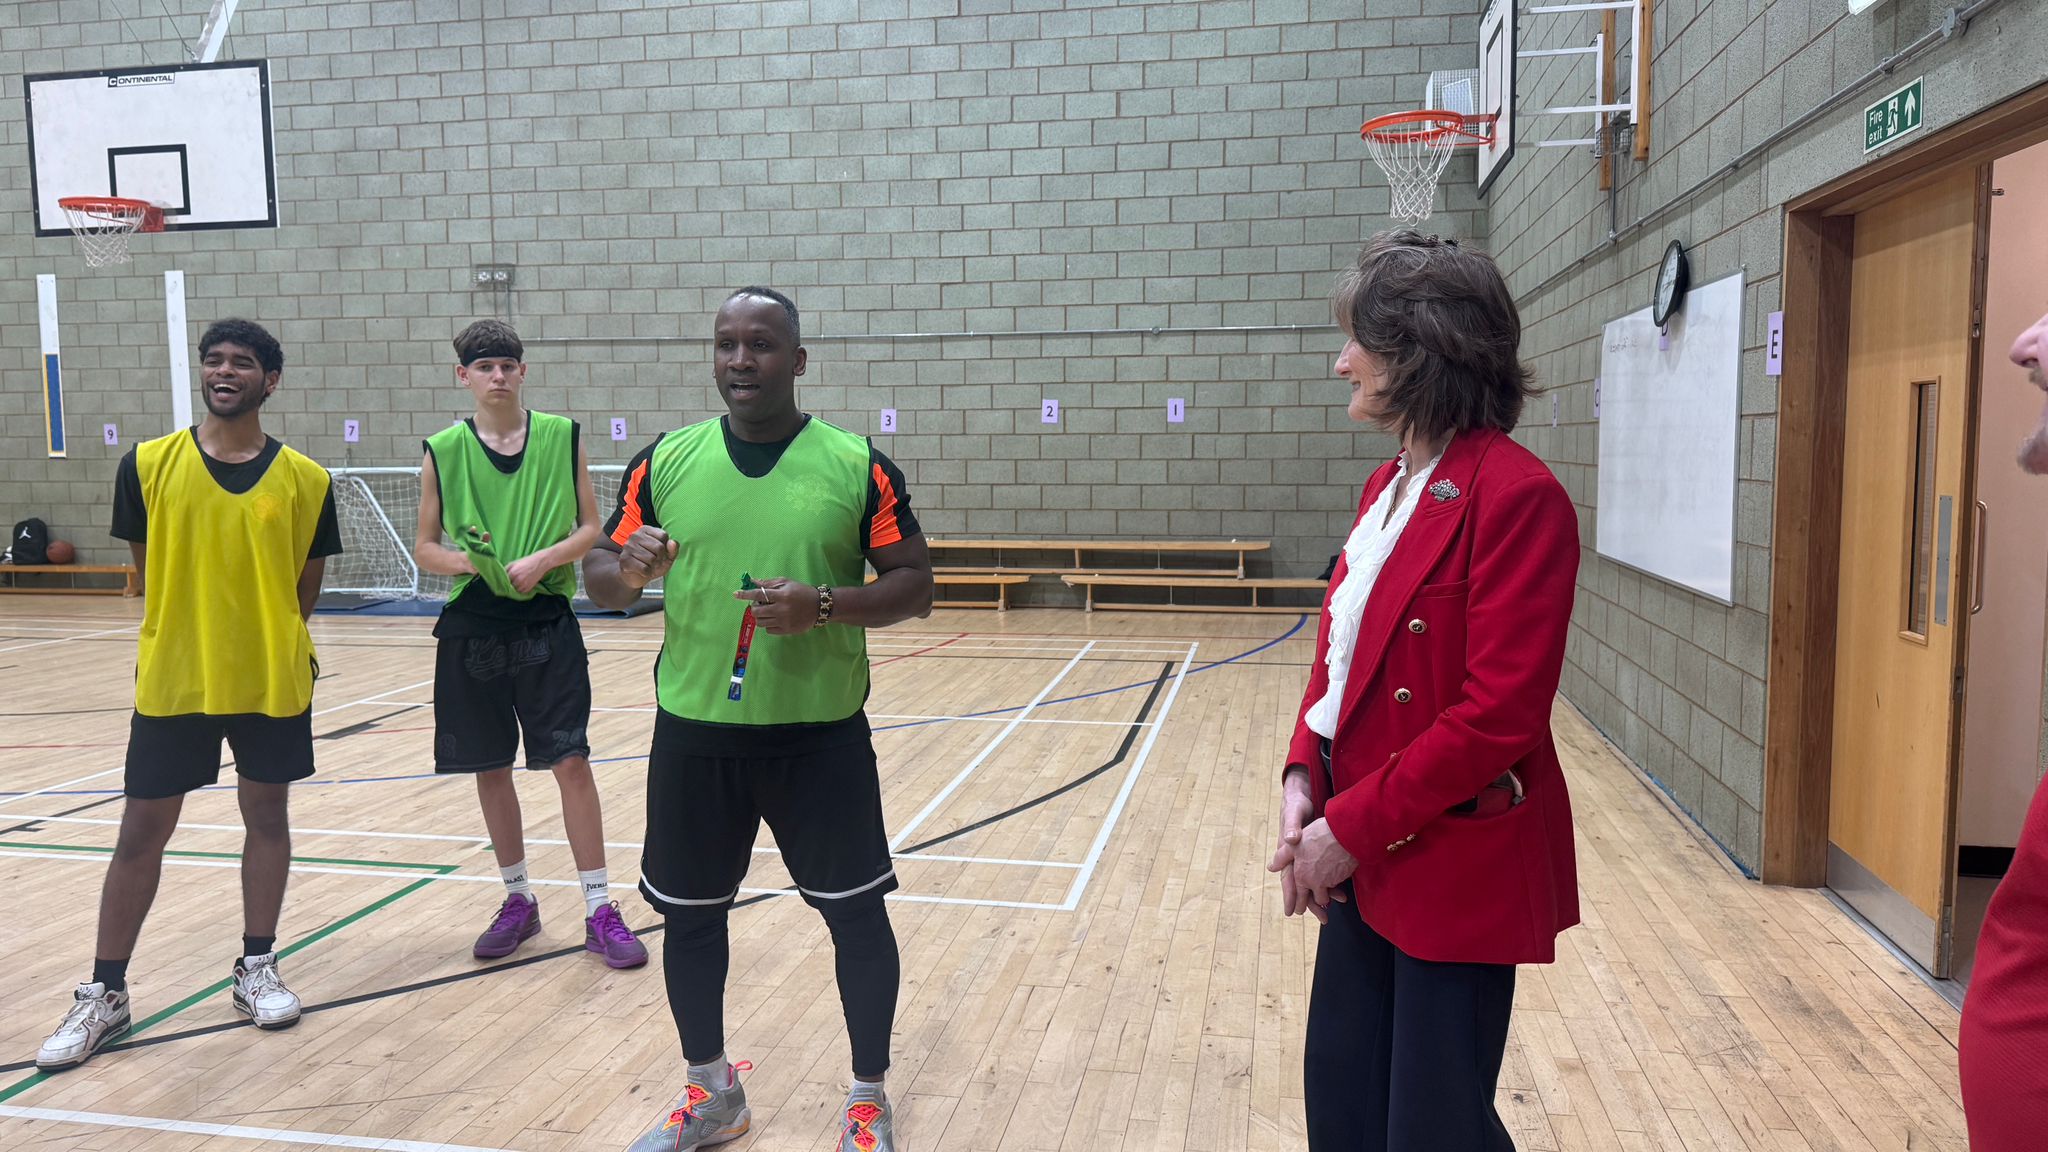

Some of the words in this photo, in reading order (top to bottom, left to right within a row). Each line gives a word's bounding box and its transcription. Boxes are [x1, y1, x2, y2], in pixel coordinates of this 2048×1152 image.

[108, 75, 173, 86] CONTINENTAL
[1869, 110, 1883, 127] Fire
[1868, 126, 1882, 145] exit
[1771, 329, 1779, 359] E
[1046, 406, 1054, 417] 2
[885, 414, 892, 427] 3
[107, 429, 114, 440] 9
[348, 425, 355, 436] 7
[615, 424, 622, 435] 5
